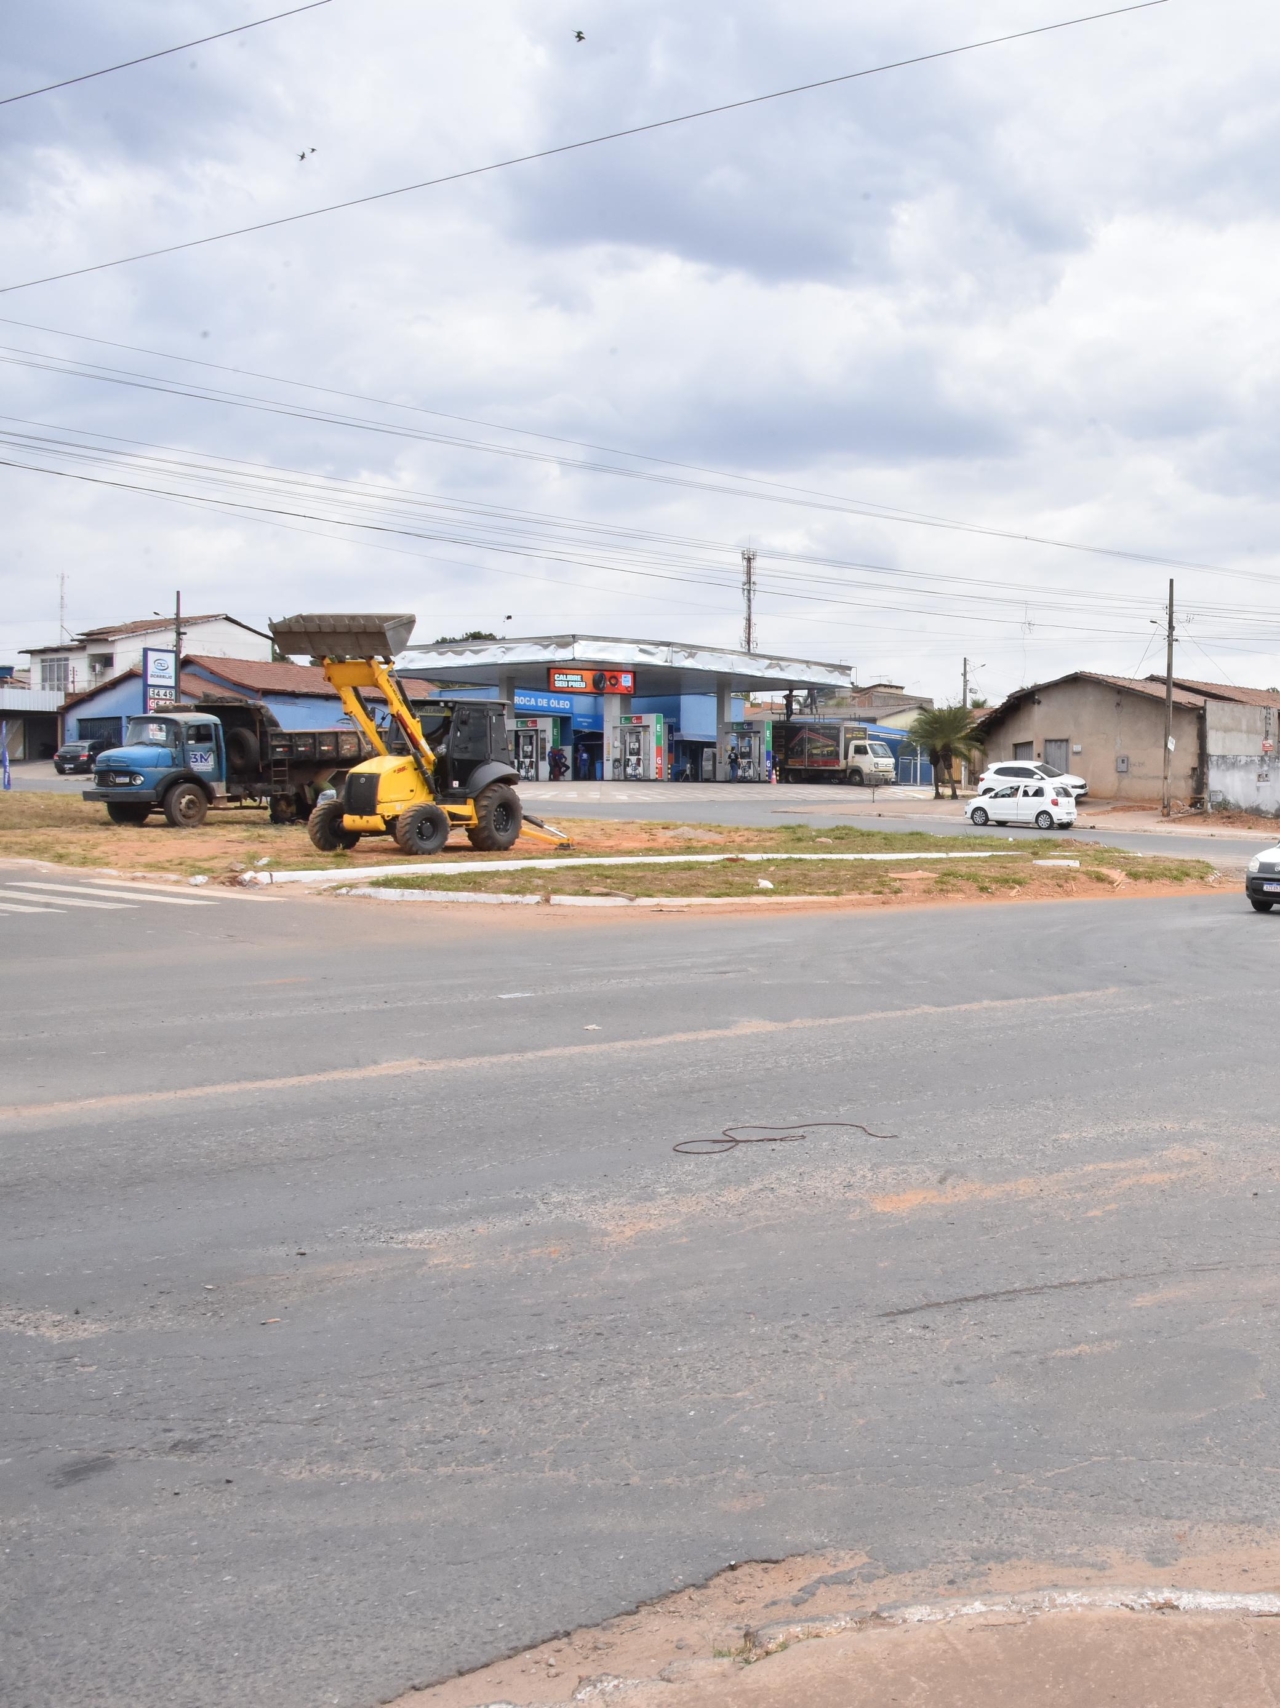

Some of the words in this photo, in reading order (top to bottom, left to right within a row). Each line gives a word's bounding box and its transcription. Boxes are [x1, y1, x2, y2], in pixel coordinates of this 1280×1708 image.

[514, 696, 536, 706] ROCA
[537, 698, 548, 707] DE
[550, 699, 571, 708] ÓLEO
[656, 756, 661, 764] G
